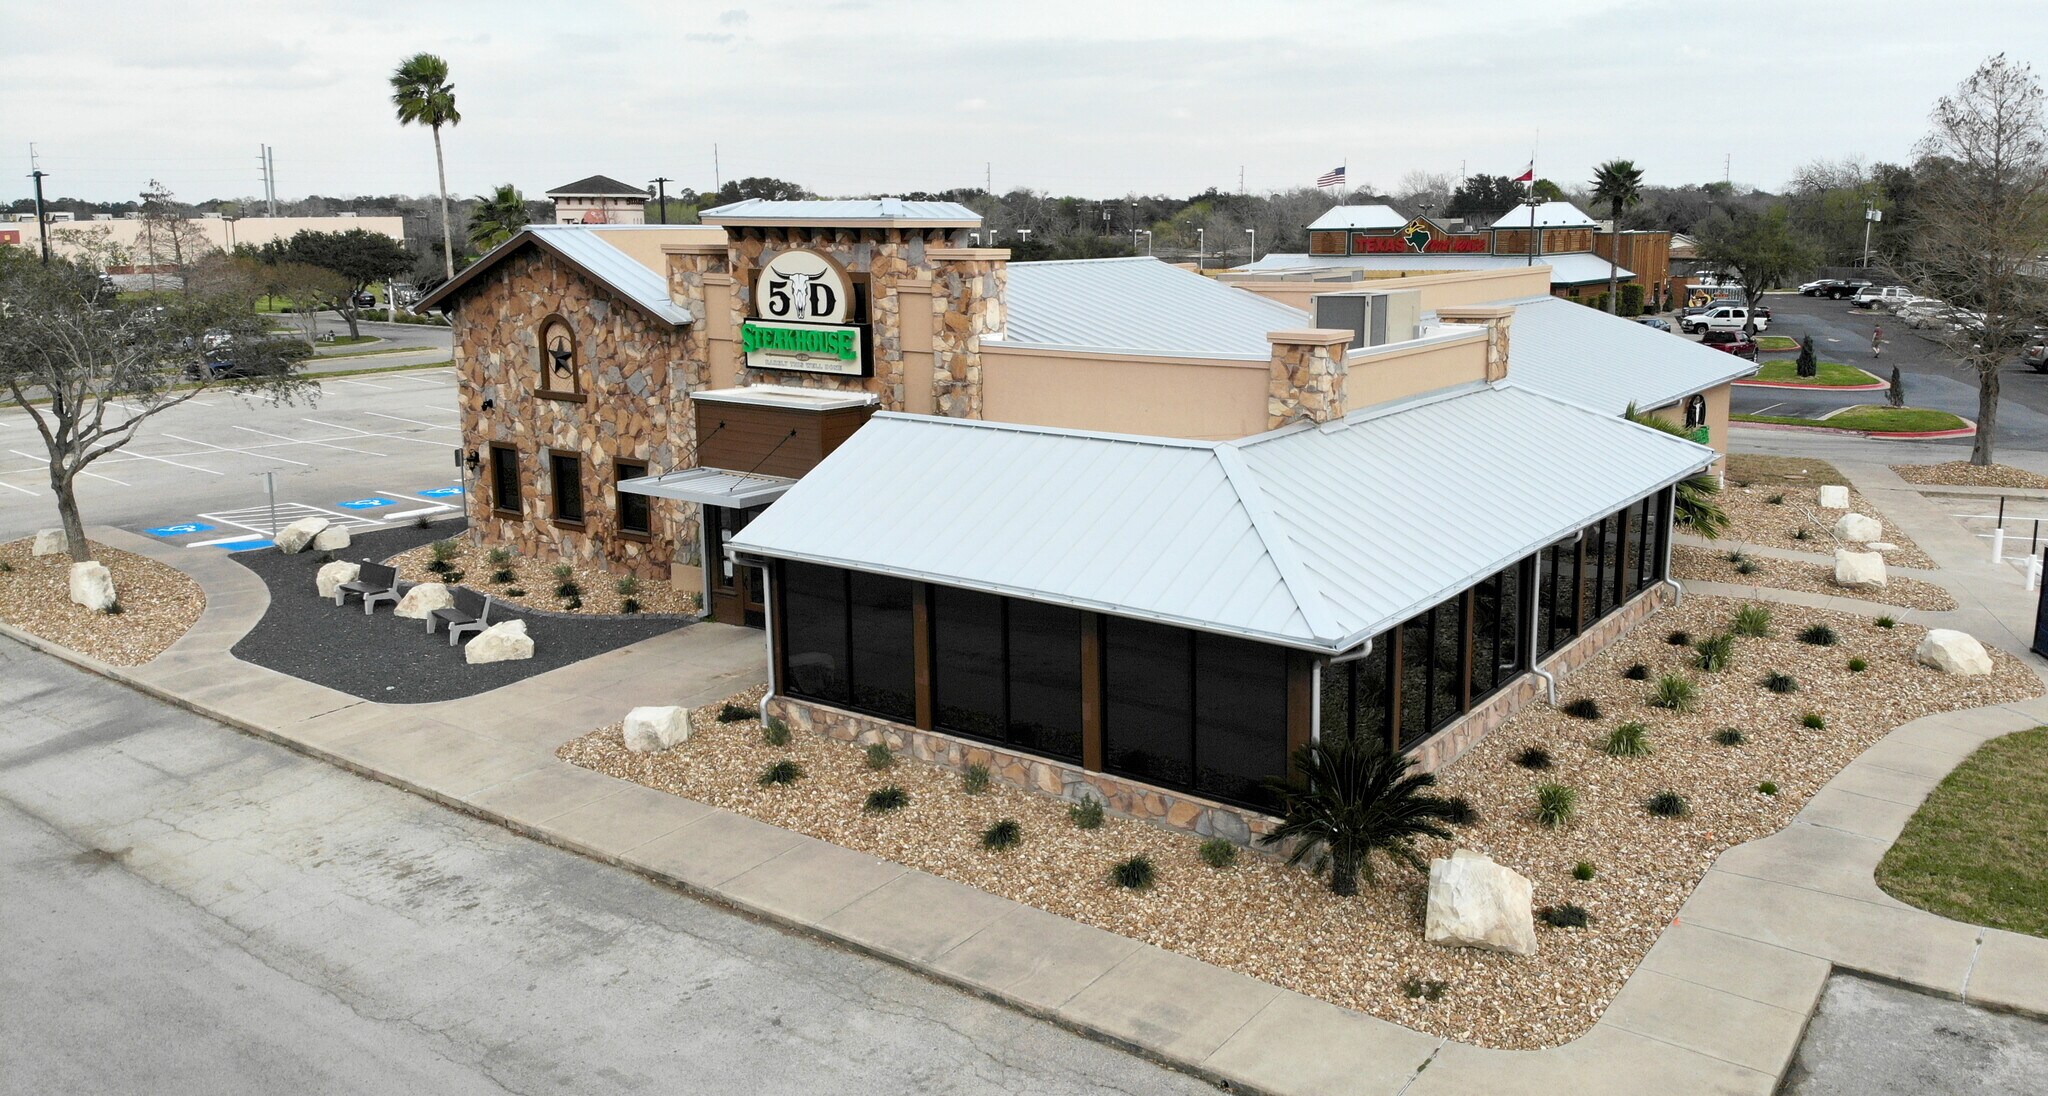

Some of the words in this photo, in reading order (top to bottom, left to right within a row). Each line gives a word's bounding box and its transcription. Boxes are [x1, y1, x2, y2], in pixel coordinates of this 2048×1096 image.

[1356, 237, 1406, 253] TEXAS
[769, 281, 791, 316] 5
[809, 283, 837, 317] D
[742, 324, 856, 360] STEAKHOUSE
